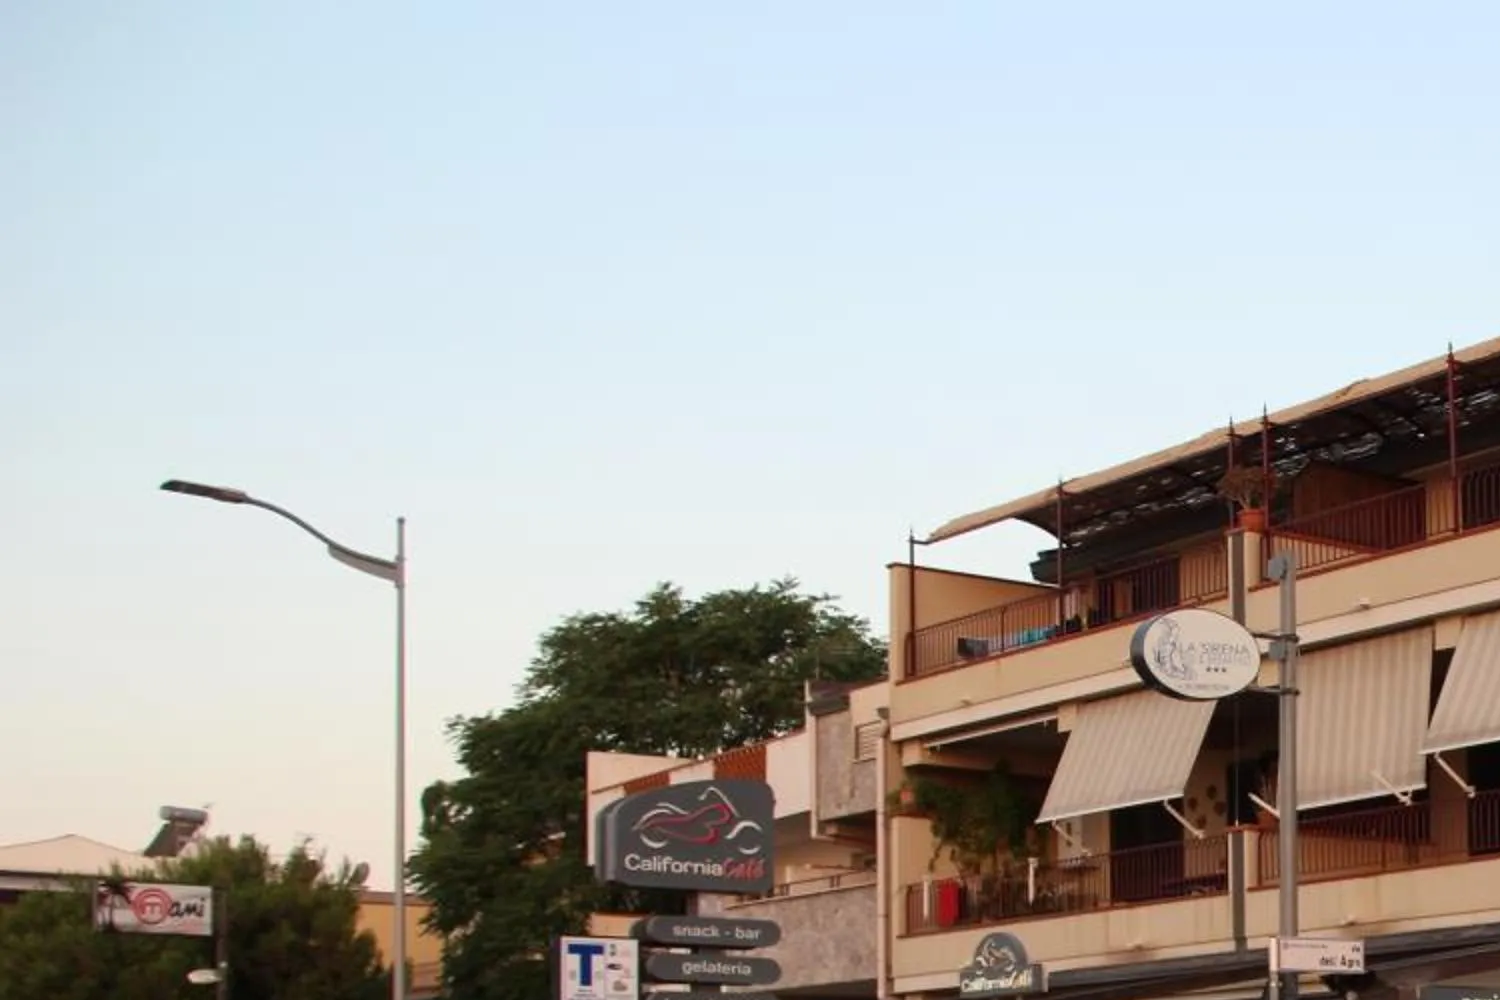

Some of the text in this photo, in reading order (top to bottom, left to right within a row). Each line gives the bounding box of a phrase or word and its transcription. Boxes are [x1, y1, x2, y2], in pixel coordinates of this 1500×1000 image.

[1201, 642, 1251, 656] SIRENA
[672, 925, 719, 937] snack
[735, 927, 760, 939] bar
[567, 943, 604, 986] T
[682, 960, 752, 975] gelateria
